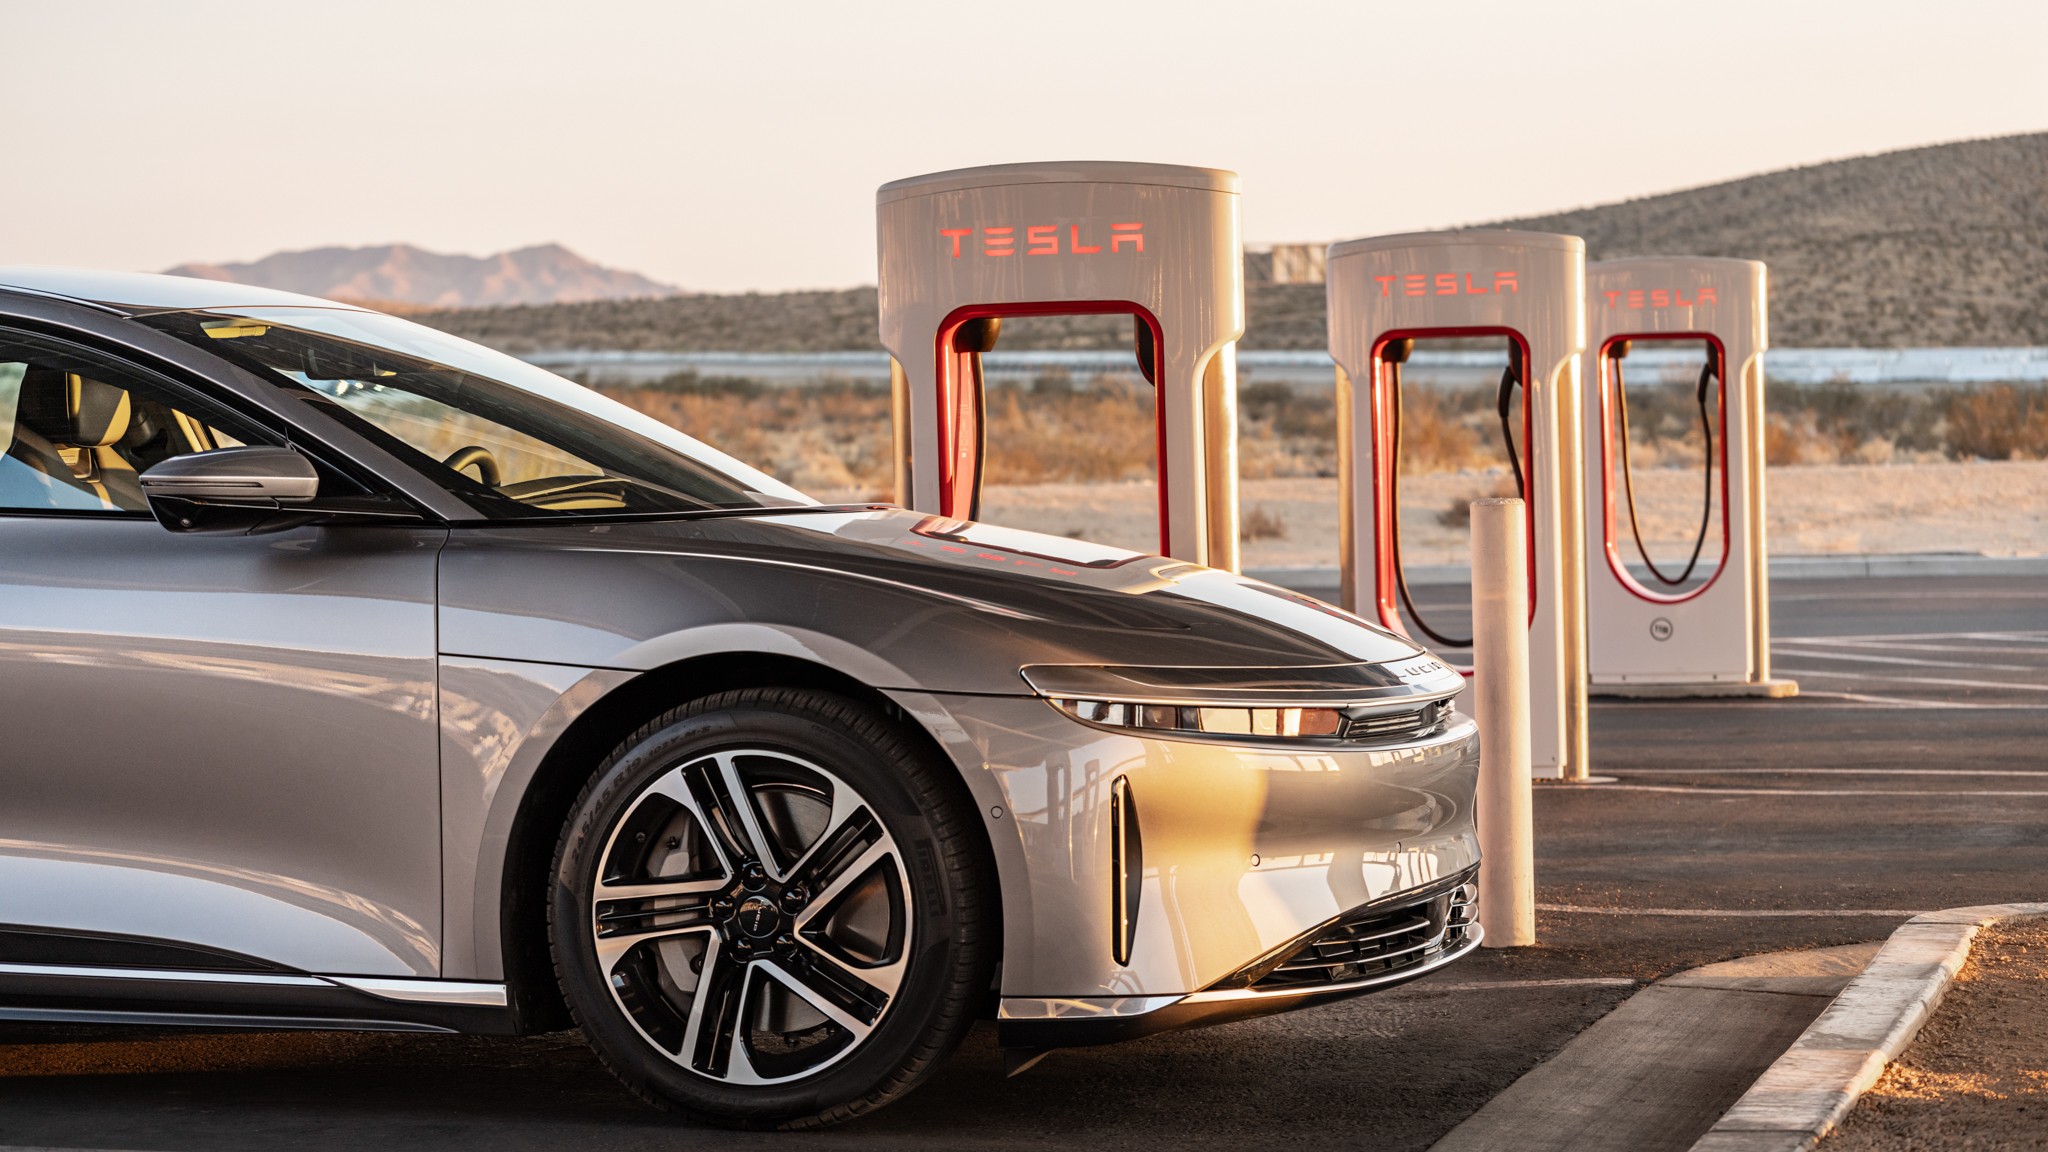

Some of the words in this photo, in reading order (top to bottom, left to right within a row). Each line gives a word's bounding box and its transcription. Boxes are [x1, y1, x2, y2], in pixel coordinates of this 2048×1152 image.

[940, 222, 1145, 258] TESLA
[1373, 271, 1518, 297] TESLA
[1603, 288, 1717, 308] TESLA
